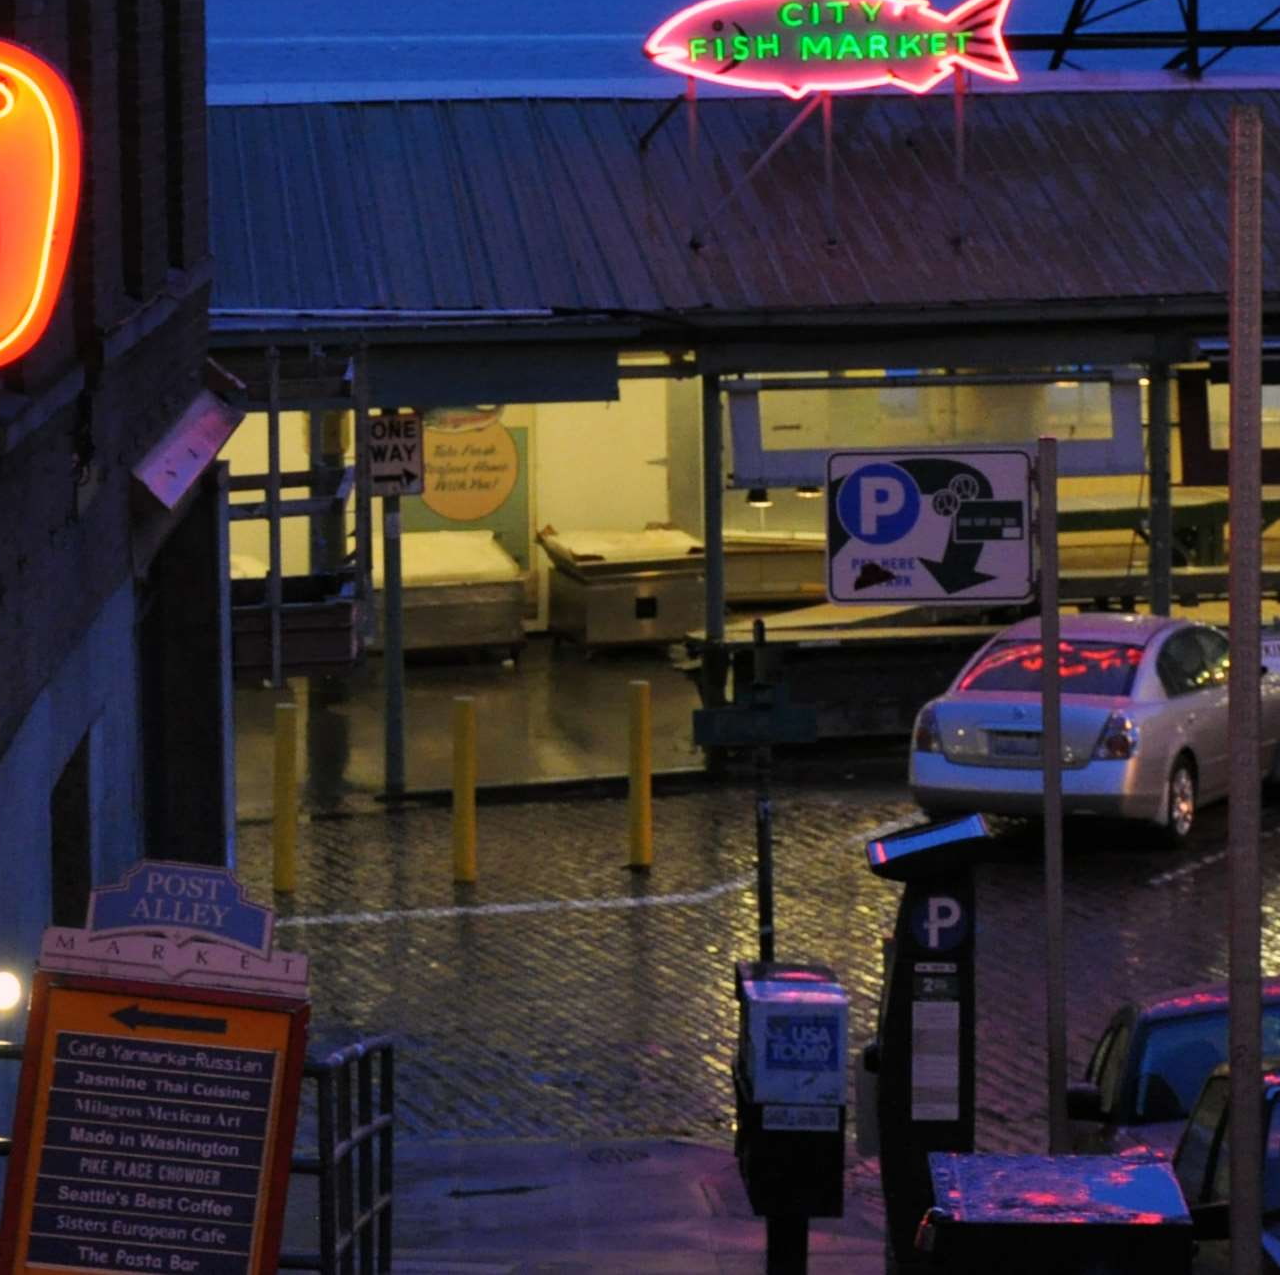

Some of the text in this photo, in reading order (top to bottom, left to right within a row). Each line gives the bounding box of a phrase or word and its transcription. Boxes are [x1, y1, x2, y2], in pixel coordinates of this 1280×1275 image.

[780, 0, 882, 27] CITY
[689, 31, 973, 62] FISH MARKET
[371, 421, 417, 439] ONE
[370, 444, 417, 463] WAY
[859, 476, 906, 535] P
[881, 557, 915, 570] HERE
[145, 870, 226, 901] POST
[129, 897, 232, 928] ALLEY
[928, 896, 961, 948] P
[56, 935, 295, 974] MARKET
[68, 1040, 107, 1059] Cafe
[791, 1026, 831, 1044] USA
[770, 1043, 832, 1062] TODAY
[75, 1071, 251, 1101] Jasmine Thai Cuisine
[75, 1098, 241, 1128] Milagros Mexican Art
[70, 1127, 239, 1158] Made in Washington
[80, 1157, 222, 1186] PIKE PLACE CHOWDER
[57, 1185, 233, 1217] Seattle's Best Coffee
[56, 1215, 108, 1233] Sisters
[112, 1220, 186, 1243] European
[78, 1246, 200, 1272] The Pasta Bar
